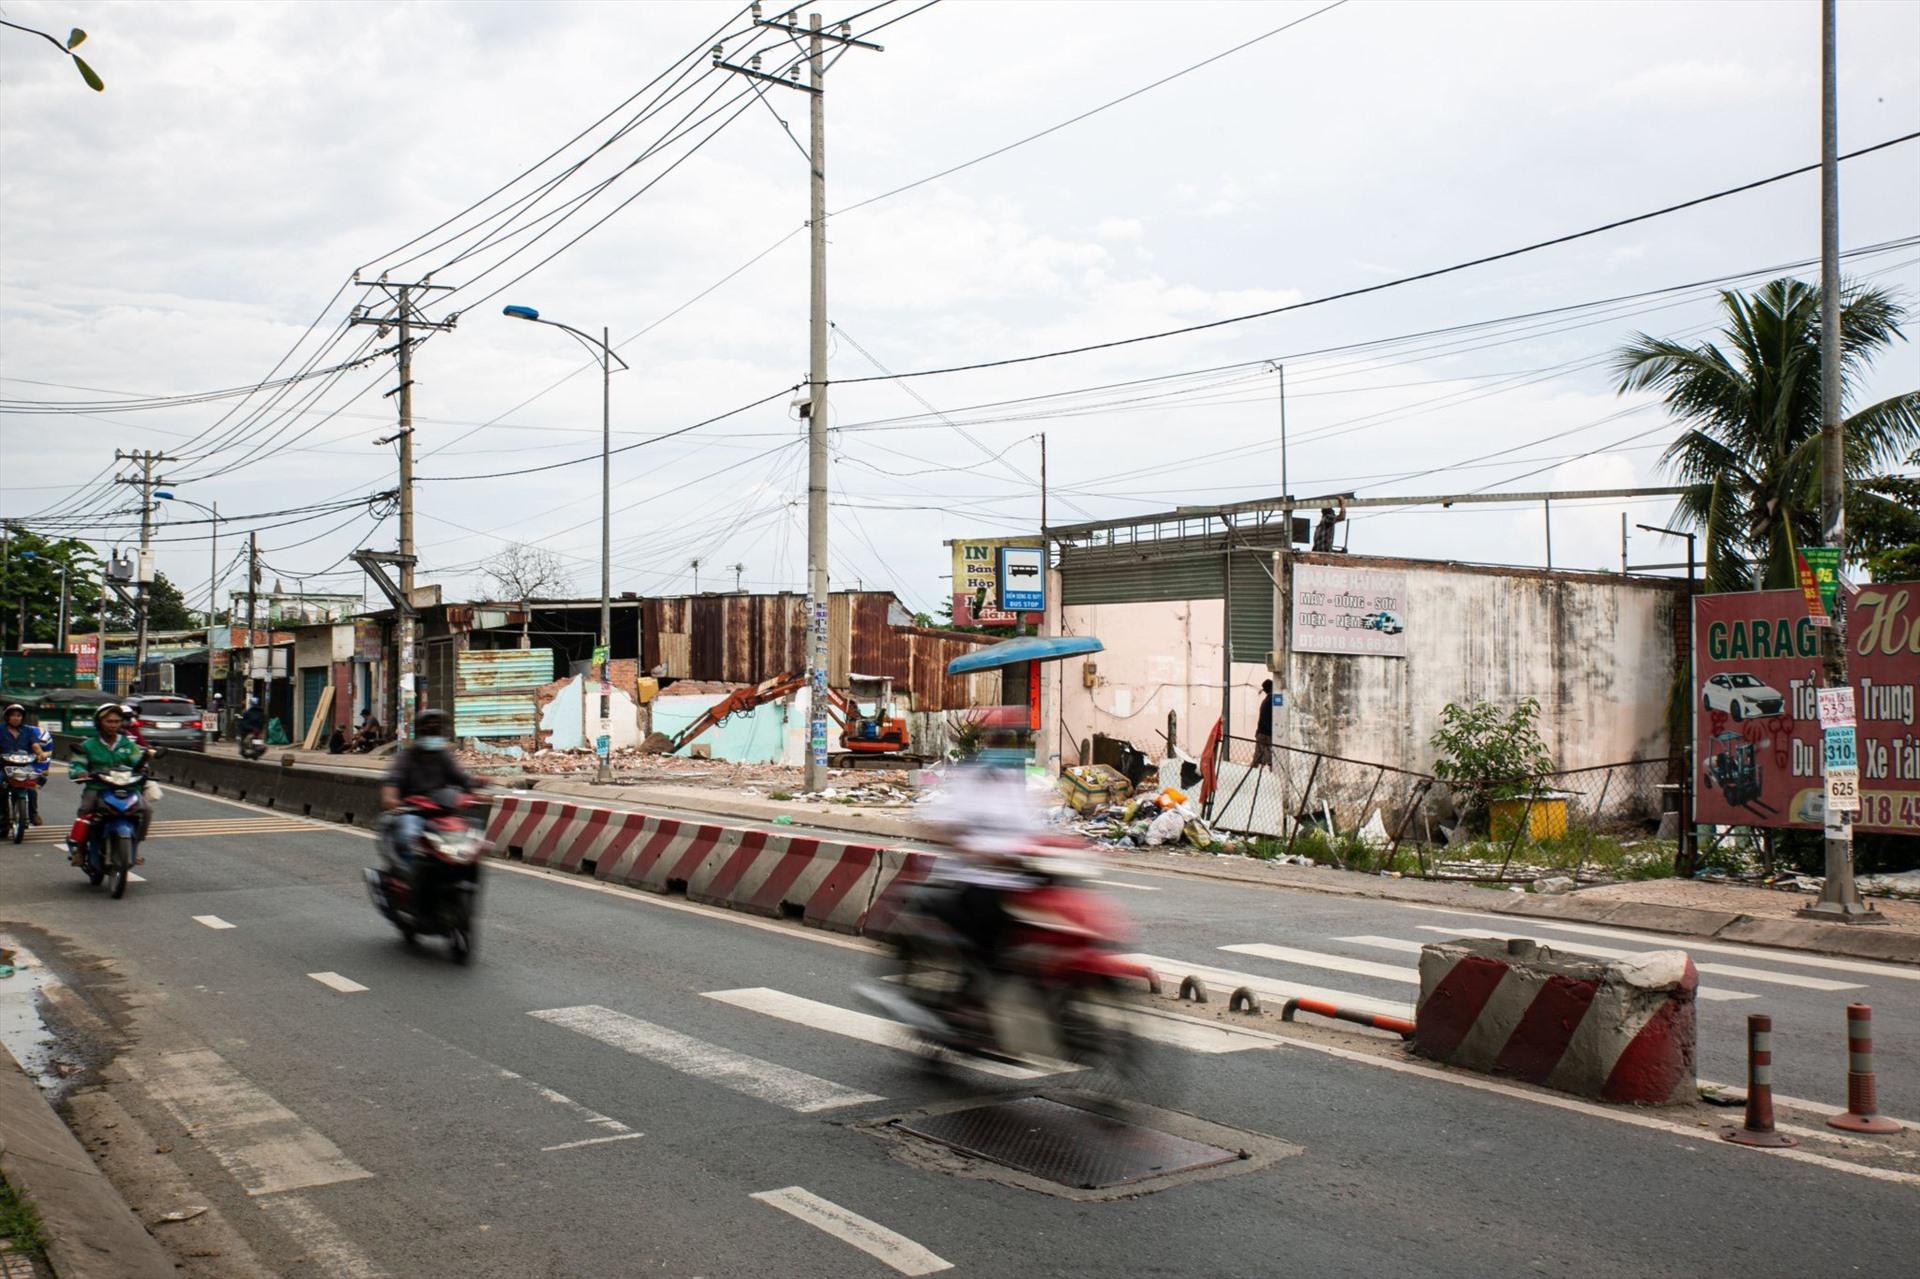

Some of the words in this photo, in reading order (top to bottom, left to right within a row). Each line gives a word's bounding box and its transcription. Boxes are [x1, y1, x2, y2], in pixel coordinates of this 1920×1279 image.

[965, 546, 989, 560] IN
[1299, 590, 1325, 607] MÁY
[1707, 619, 1824, 661] GARAG
[1790, 668, 1817, 721] Tiể
[1861, 678, 1914, 726] Trung
[1792, 738, 1814, 777] Du
[1865, 738, 1892, 779] Xe
[1828, 744, 1851, 760] 310
[1832, 782, 1854, 796] 625
